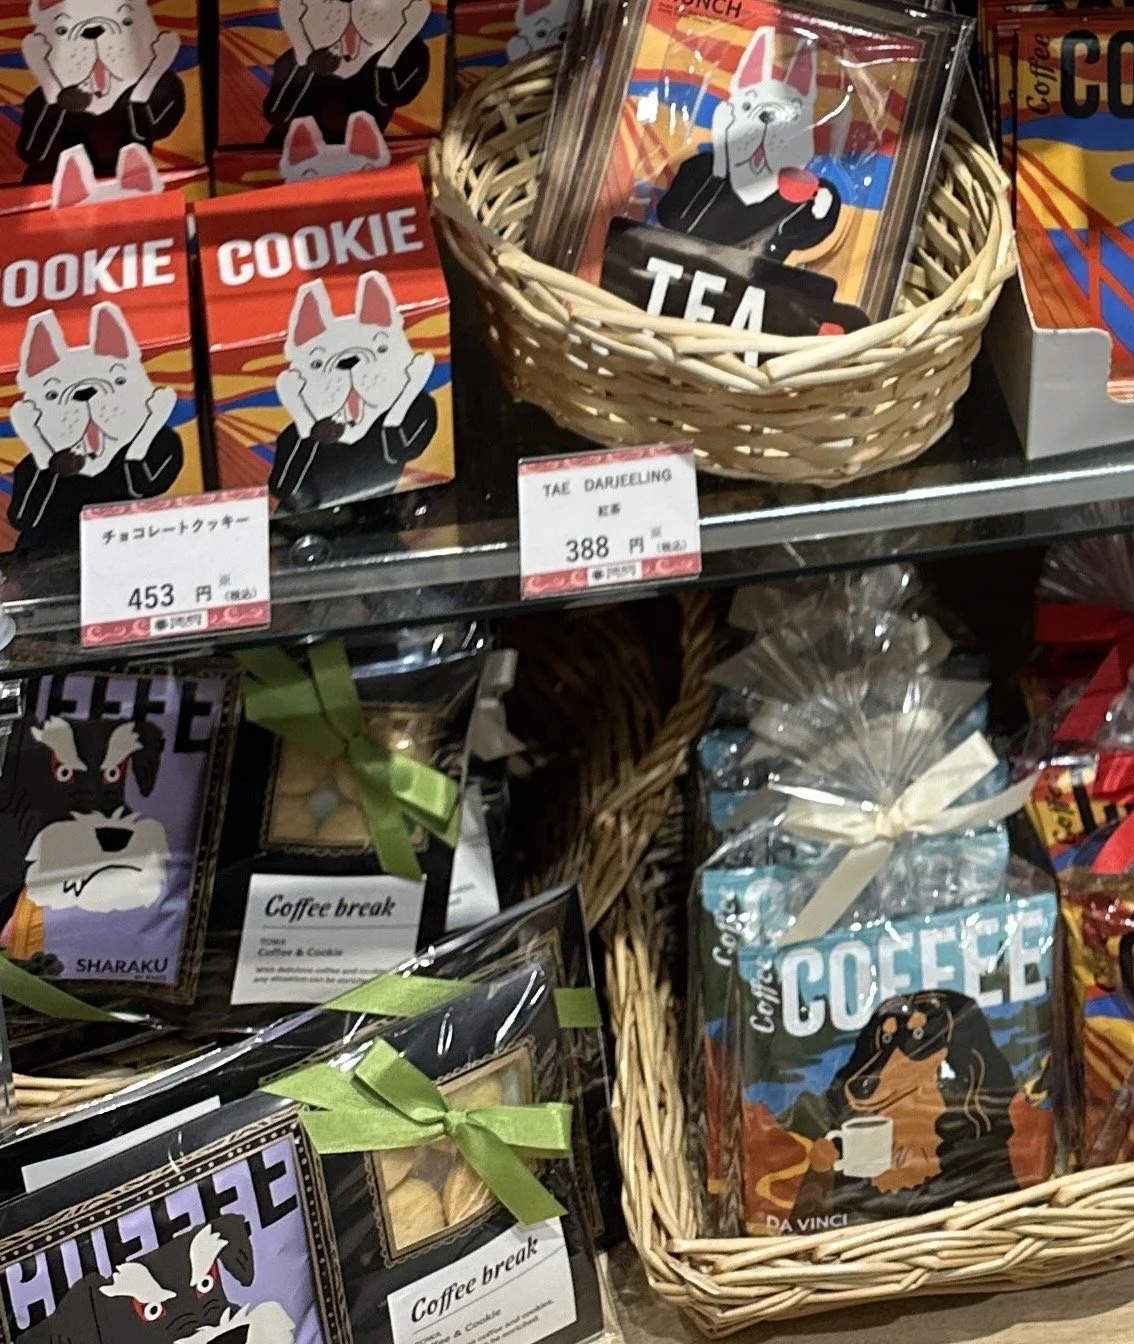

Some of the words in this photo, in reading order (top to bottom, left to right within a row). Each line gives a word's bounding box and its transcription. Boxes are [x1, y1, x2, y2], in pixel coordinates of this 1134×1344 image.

[1025, 32, 1052, 116] Coffee
[216, 207, 424, 287] COOKIE
[645, 257, 767, 344] TEA
[543, 481, 571, 498] TAE
[584, 469, 672, 492] DARJEELING
[102, 514, 249, 545] チョコレートクッキー
[566, 535, 609, 562] 388
[128, 583, 174, 611] 453
[265, 894, 332, 923] Coffee
[335, 895, 396, 917] break
[75, 958, 169, 974] SHARAKU
[781, 910, 1050, 1037] COFFEE
[766, 1215, 793, 1234] DA
[797, 1213, 849, 1230] VINCI
[412, 1277, 477, 1323] Coffee
[482, 1236, 538, 1285] break
